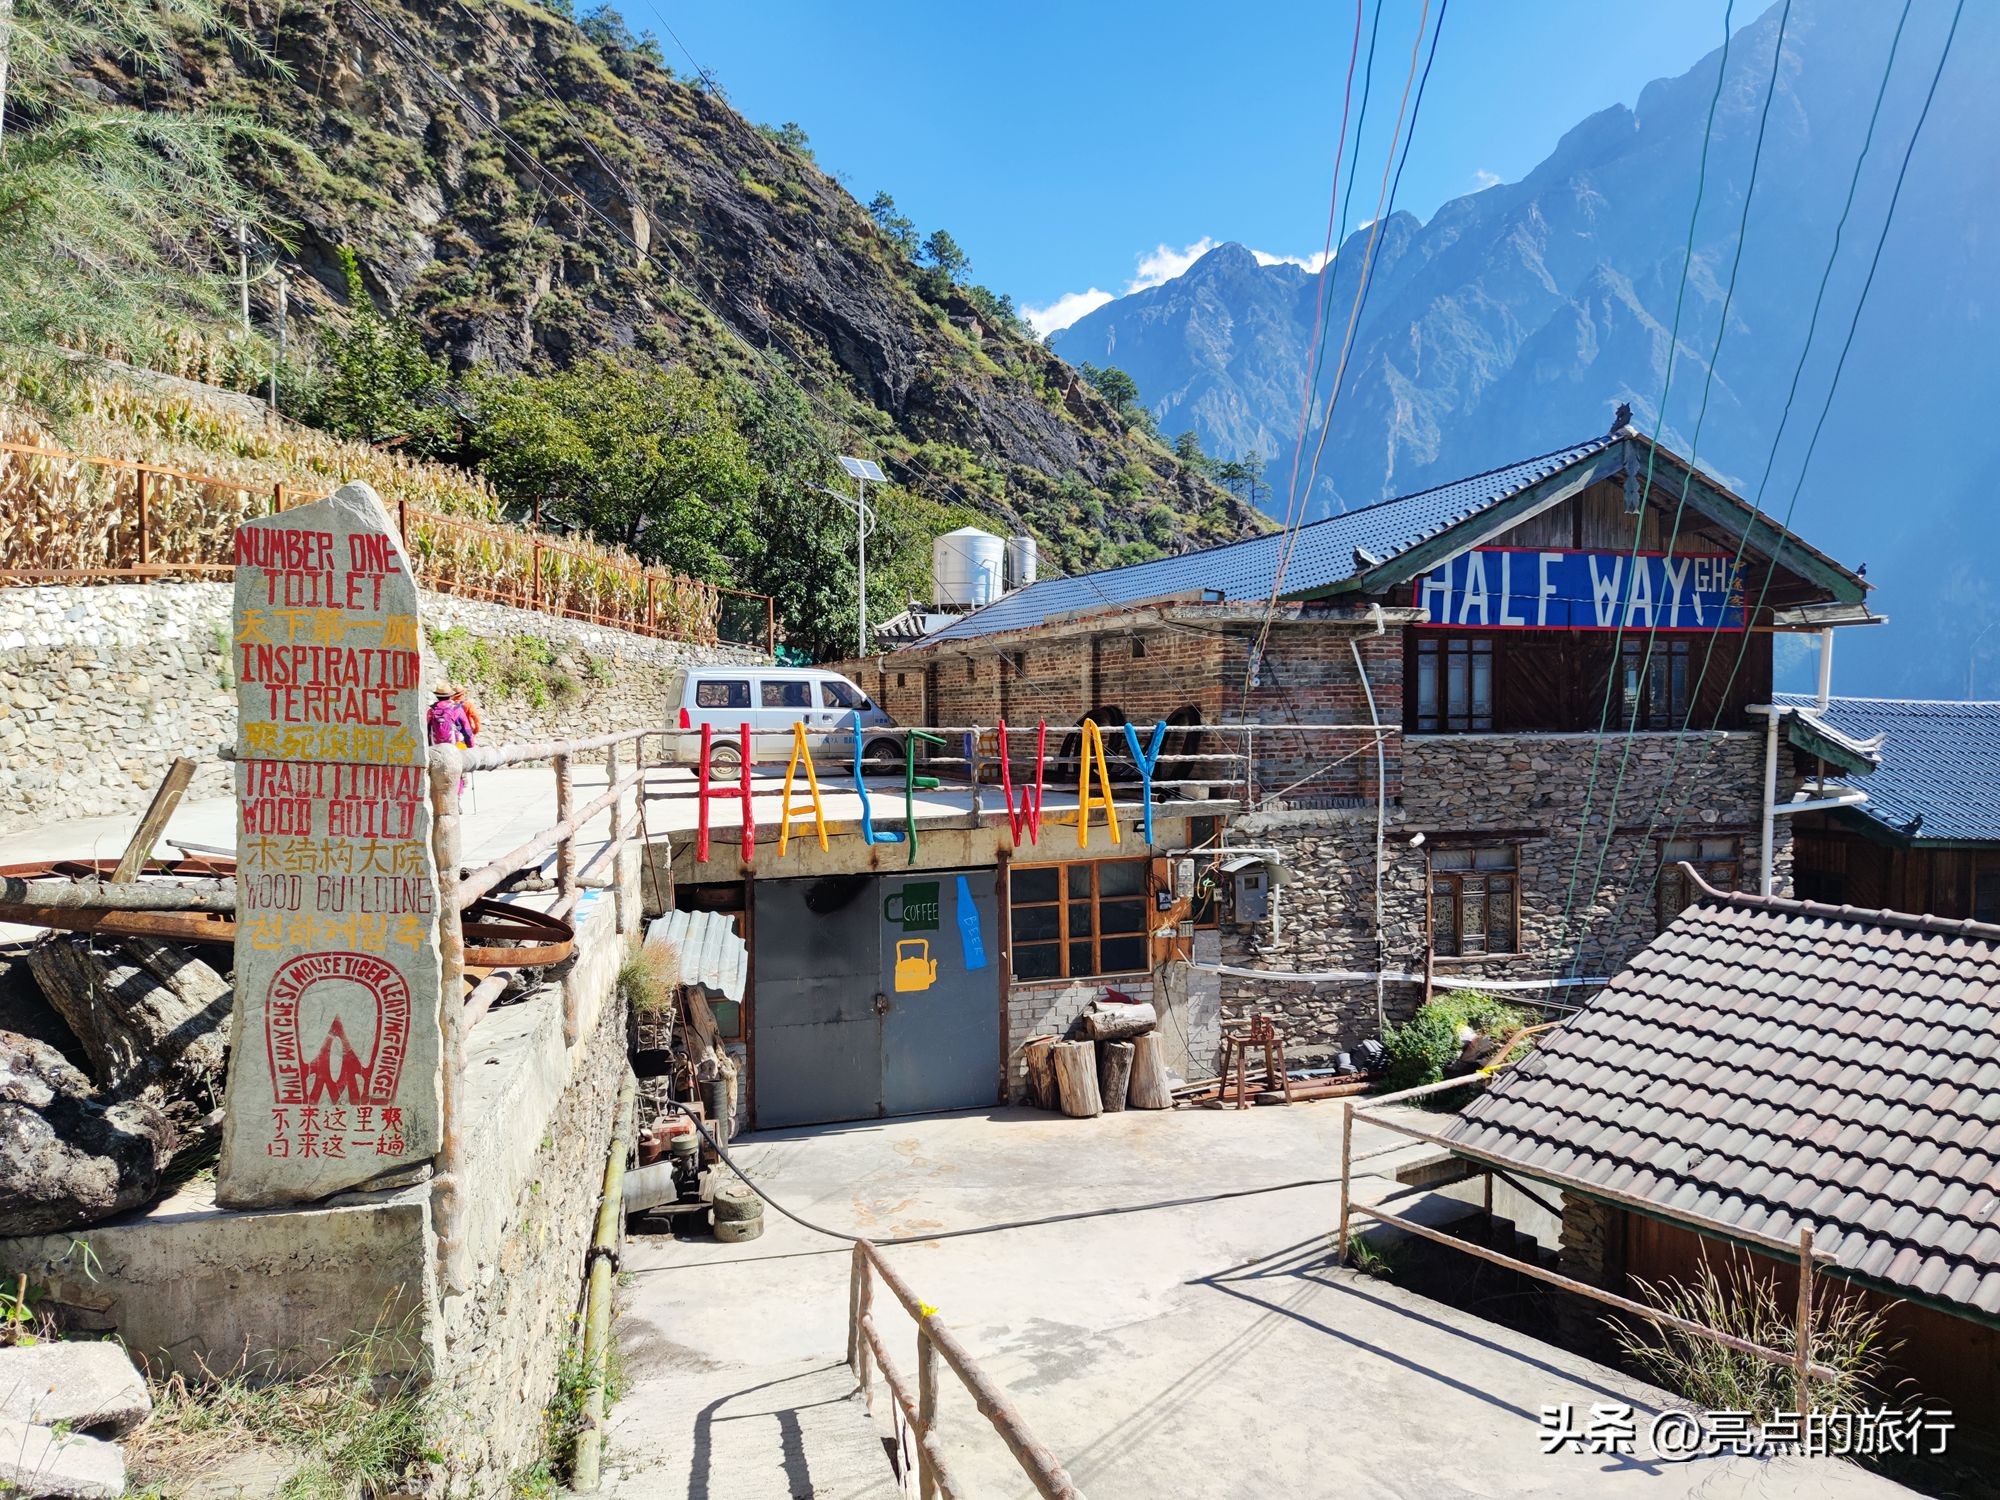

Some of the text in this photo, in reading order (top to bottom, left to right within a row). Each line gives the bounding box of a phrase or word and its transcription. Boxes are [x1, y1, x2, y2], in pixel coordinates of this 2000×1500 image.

[235, 526, 401, 573] NUMBER ONE
[263, 568, 386, 611] TOILET
[1421, 550, 1564, 626] HALF
[1588, 554, 1691, 628] WAY
[240, 643, 421, 691] INSPIRATION
[264, 683, 402, 727] TERRACE
[242, 760, 425, 800] TRADITIONAL
[696, 710, 1167, 866] HALF WAY
[242, 799, 416, 840] WOOD BUILD
[246, 836, 427, 876] 木结构大院
[244, 873, 433, 914] WOOD BUILDING
[903, 902, 939, 922] COFFEE
[273, 1029, 296, 1061] WAY
[279, 1062, 301, 1101] HALF
[271, 1105, 403, 1133] 不来这里爽
[267, 1132, 405, 1159] 白来这一趟
